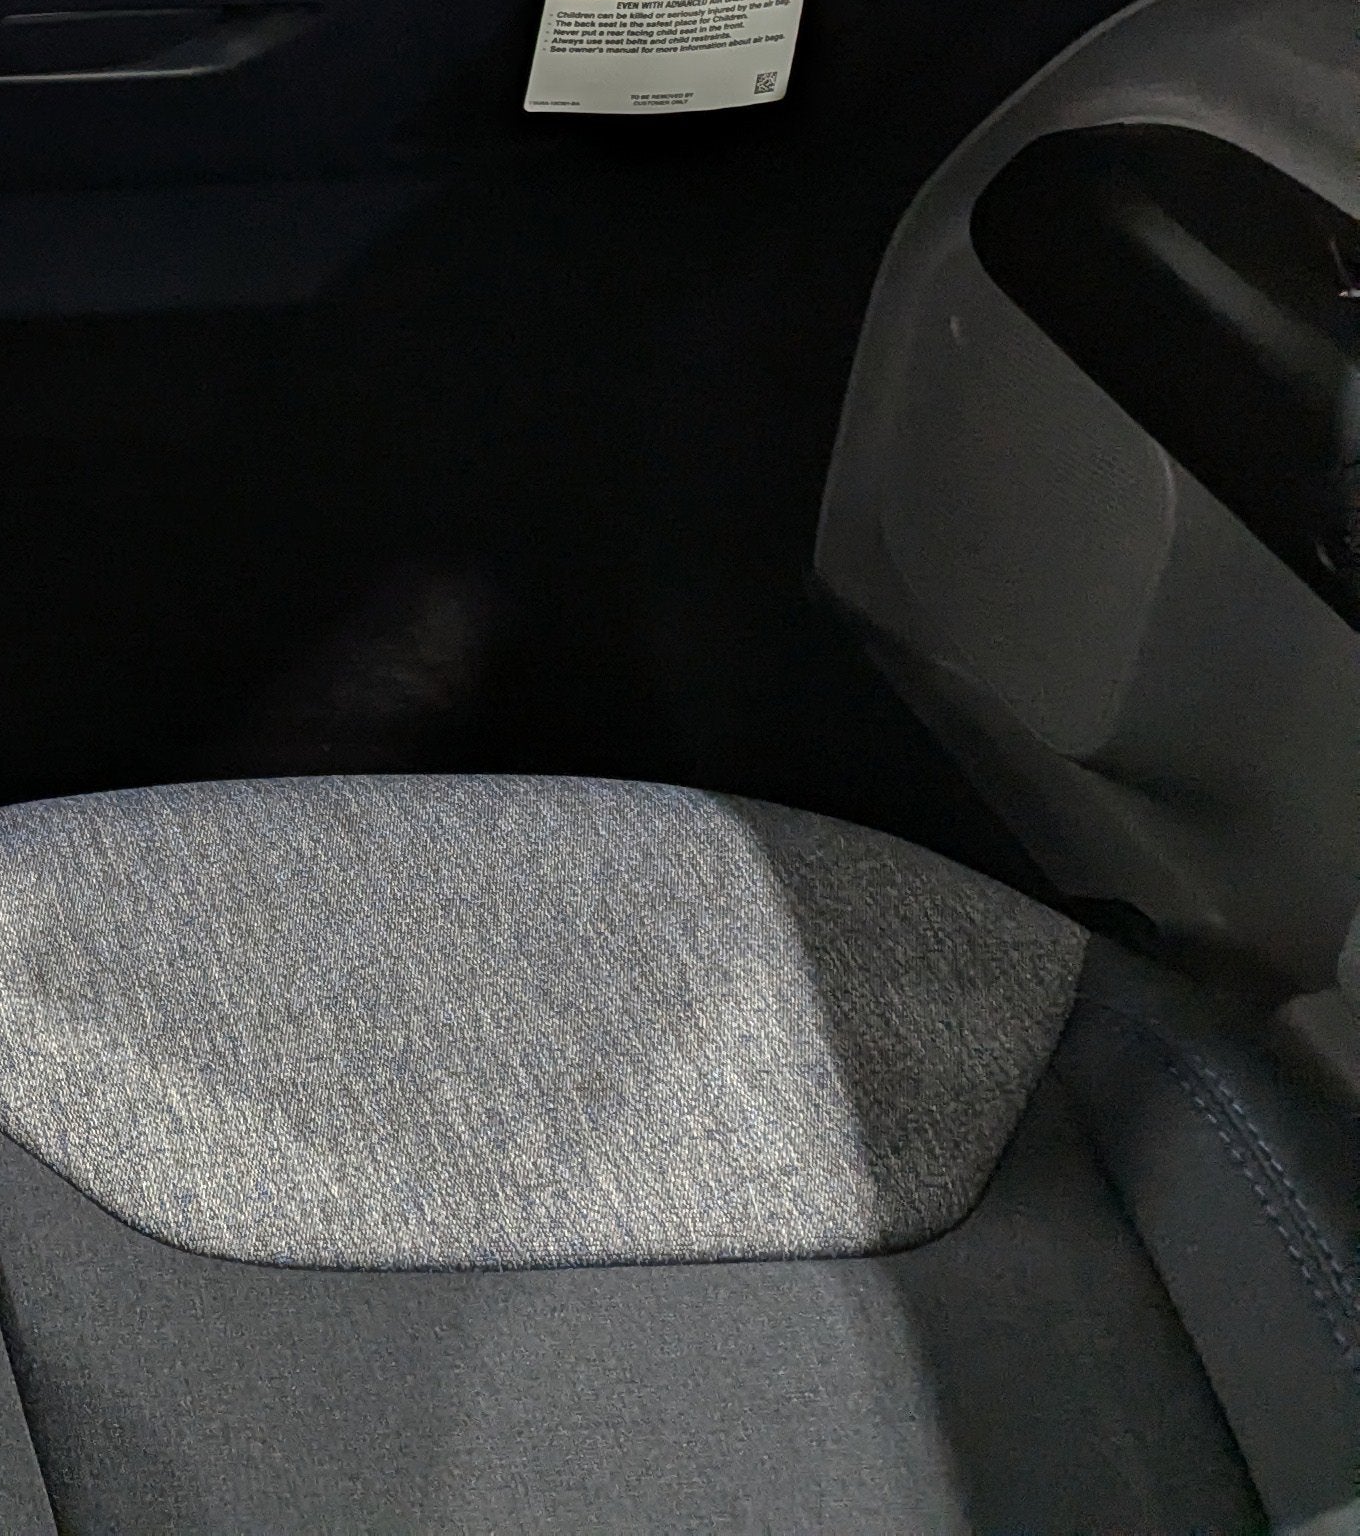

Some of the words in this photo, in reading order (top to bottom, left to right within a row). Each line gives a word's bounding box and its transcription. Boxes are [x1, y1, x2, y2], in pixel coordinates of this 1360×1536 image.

[556, 11, 595, 19] Children
[667, 9, 706, 19] seriously
[708, 5, 736, 15] injured
[737, 4, 748, 12] by
[763, 0, 774, 8] air
[616, 1, 639, 9] EVEN
[641, 1, 663, 9] WITH
[674, 19, 697, 27] place
[699, 17, 711, 25] for
[581, 29, 597, 37] put
[627, 29, 654, 38] facing
[656, 28, 678, 36] child
[679, 26, 698, 35] seat
[699, 25, 707, 33] in
[708, 24, 722, 32] the
[551, 38, 584, 46] Always
[649, 37, 667, 45] and
[668, 36, 689, 44] child
[680, 42, 727, 52] information
[728, 38, 751, 47] about
